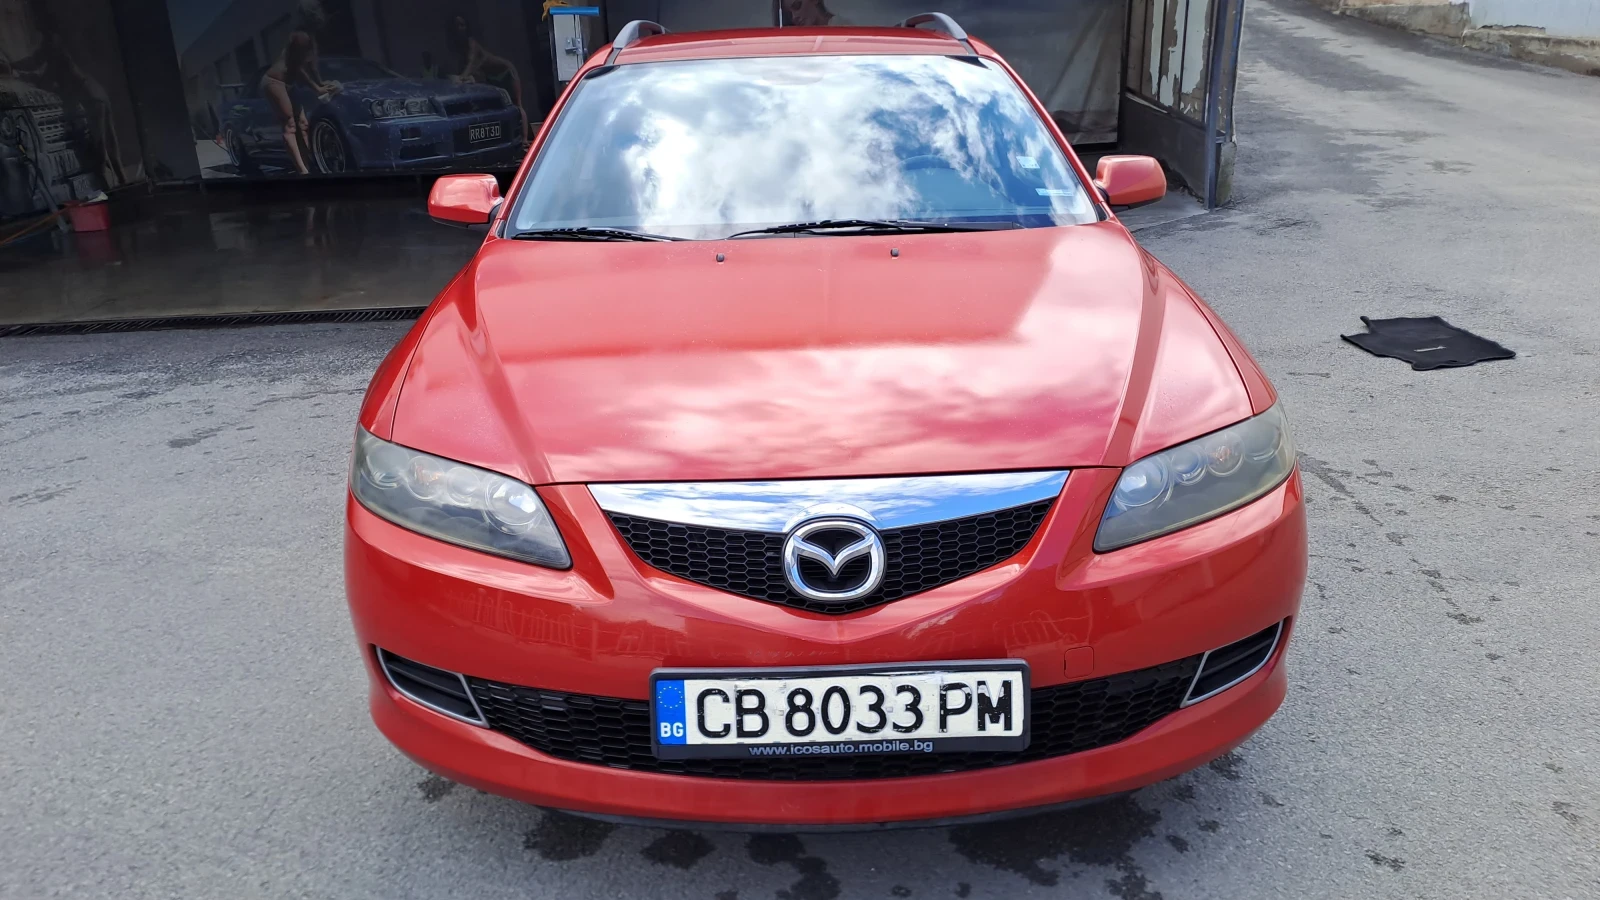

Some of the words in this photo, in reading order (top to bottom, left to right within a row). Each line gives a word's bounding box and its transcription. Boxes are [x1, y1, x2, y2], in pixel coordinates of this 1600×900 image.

[470, 125, 500, 140] RR8T3D
[697, 688, 769, 738] CB
[785, 684, 924, 737] 8033
[939, 680, 1012, 733] PM
[660, 722, 684, 738] BG
[749, 739, 934, 756] www.icosauto.mobile.bg
